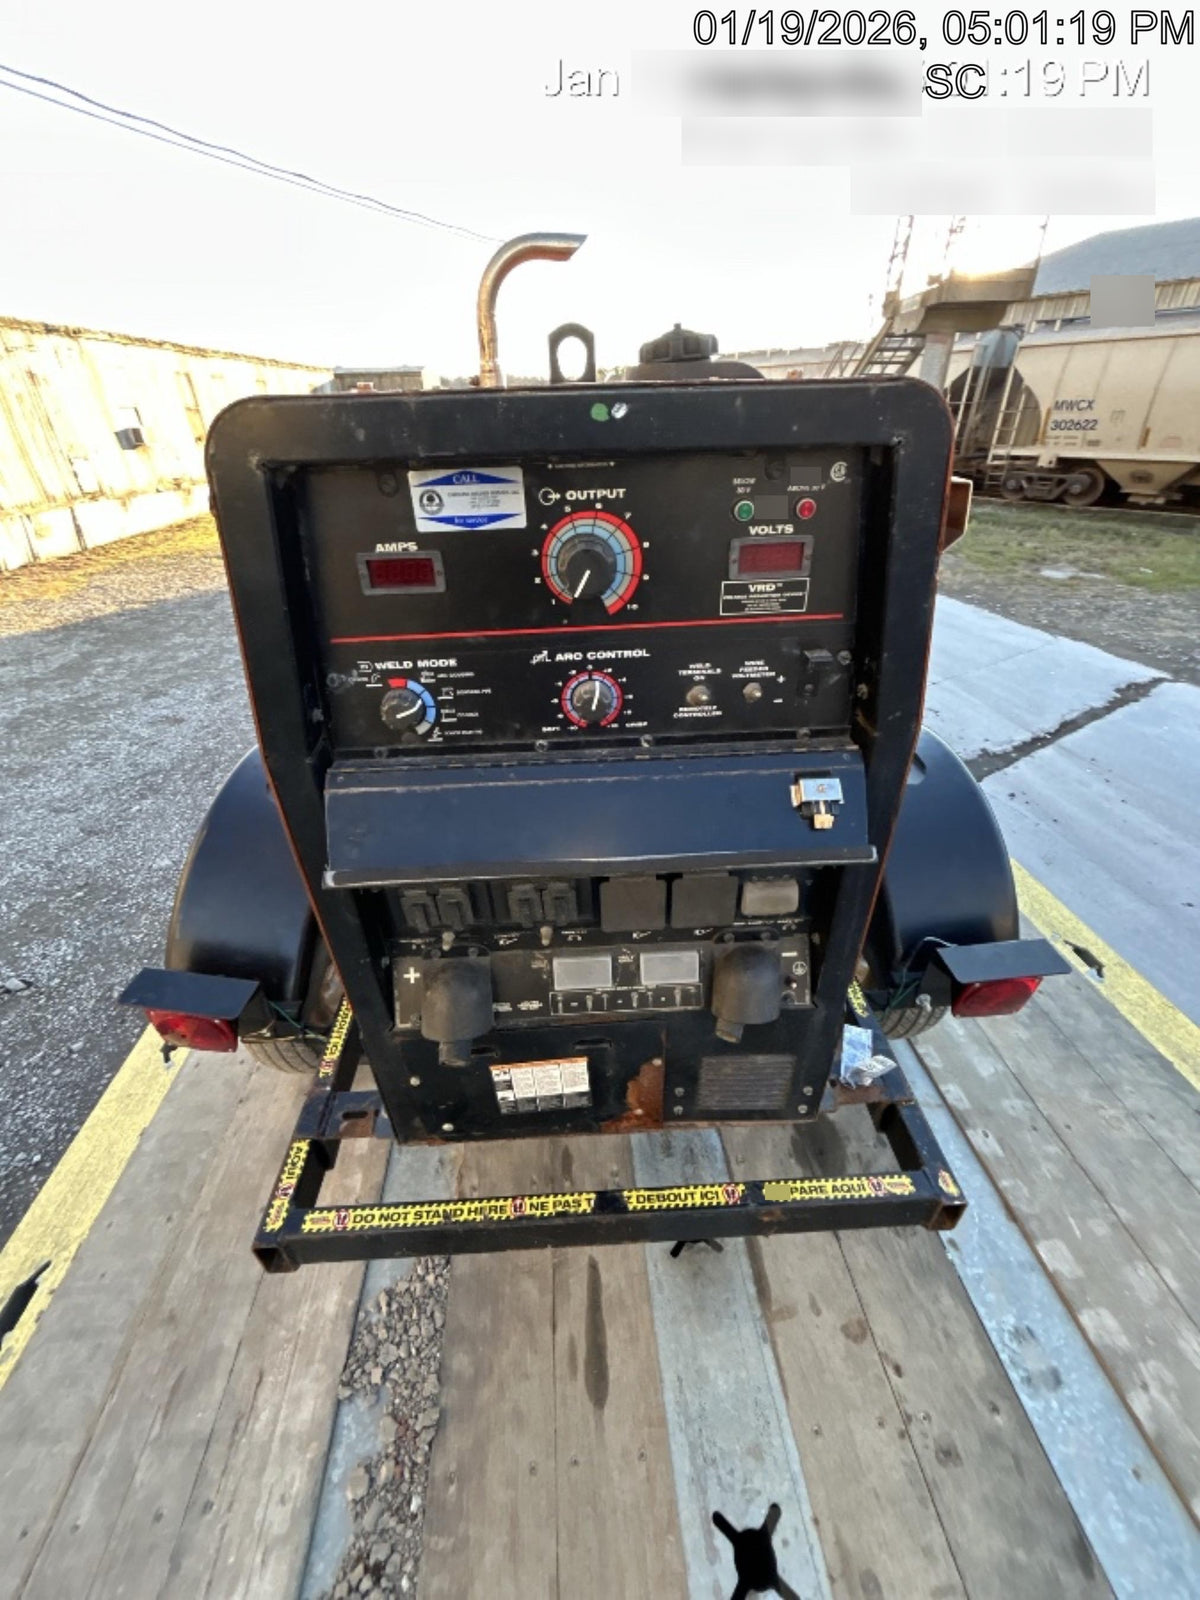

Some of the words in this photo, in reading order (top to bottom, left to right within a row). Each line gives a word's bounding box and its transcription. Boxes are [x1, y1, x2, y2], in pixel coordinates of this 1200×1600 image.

[1053, 400, 1096, 411] MWCX
[1050, 419, 1098, 431] 302622
[452, 474, 480, 484] CALL
[565, 488, 627, 501] OUTPUT
[748, 524, 794, 536] VOLTS
[375, 541, 418, 553] AMPS
[555, 652, 583, 662] ARC
[586, 649, 651, 660] CONTROL
[375, 660, 413, 670] WELD
[417, 658, 458, 668] MODE
[790, 1185, 828, 1195] PARE
[636, 1192, 697, 1204] DEBOUT
[700, 1190, 720, 1201] ICI
[529, 1201, 550, 1212] NE
[552, 1198, 581, 1210] PAS
[352, 1213, 376, 1224] DO
[378, 1212, 411, 1222] NOT
[412, 1208, 464, 1221] STAND
